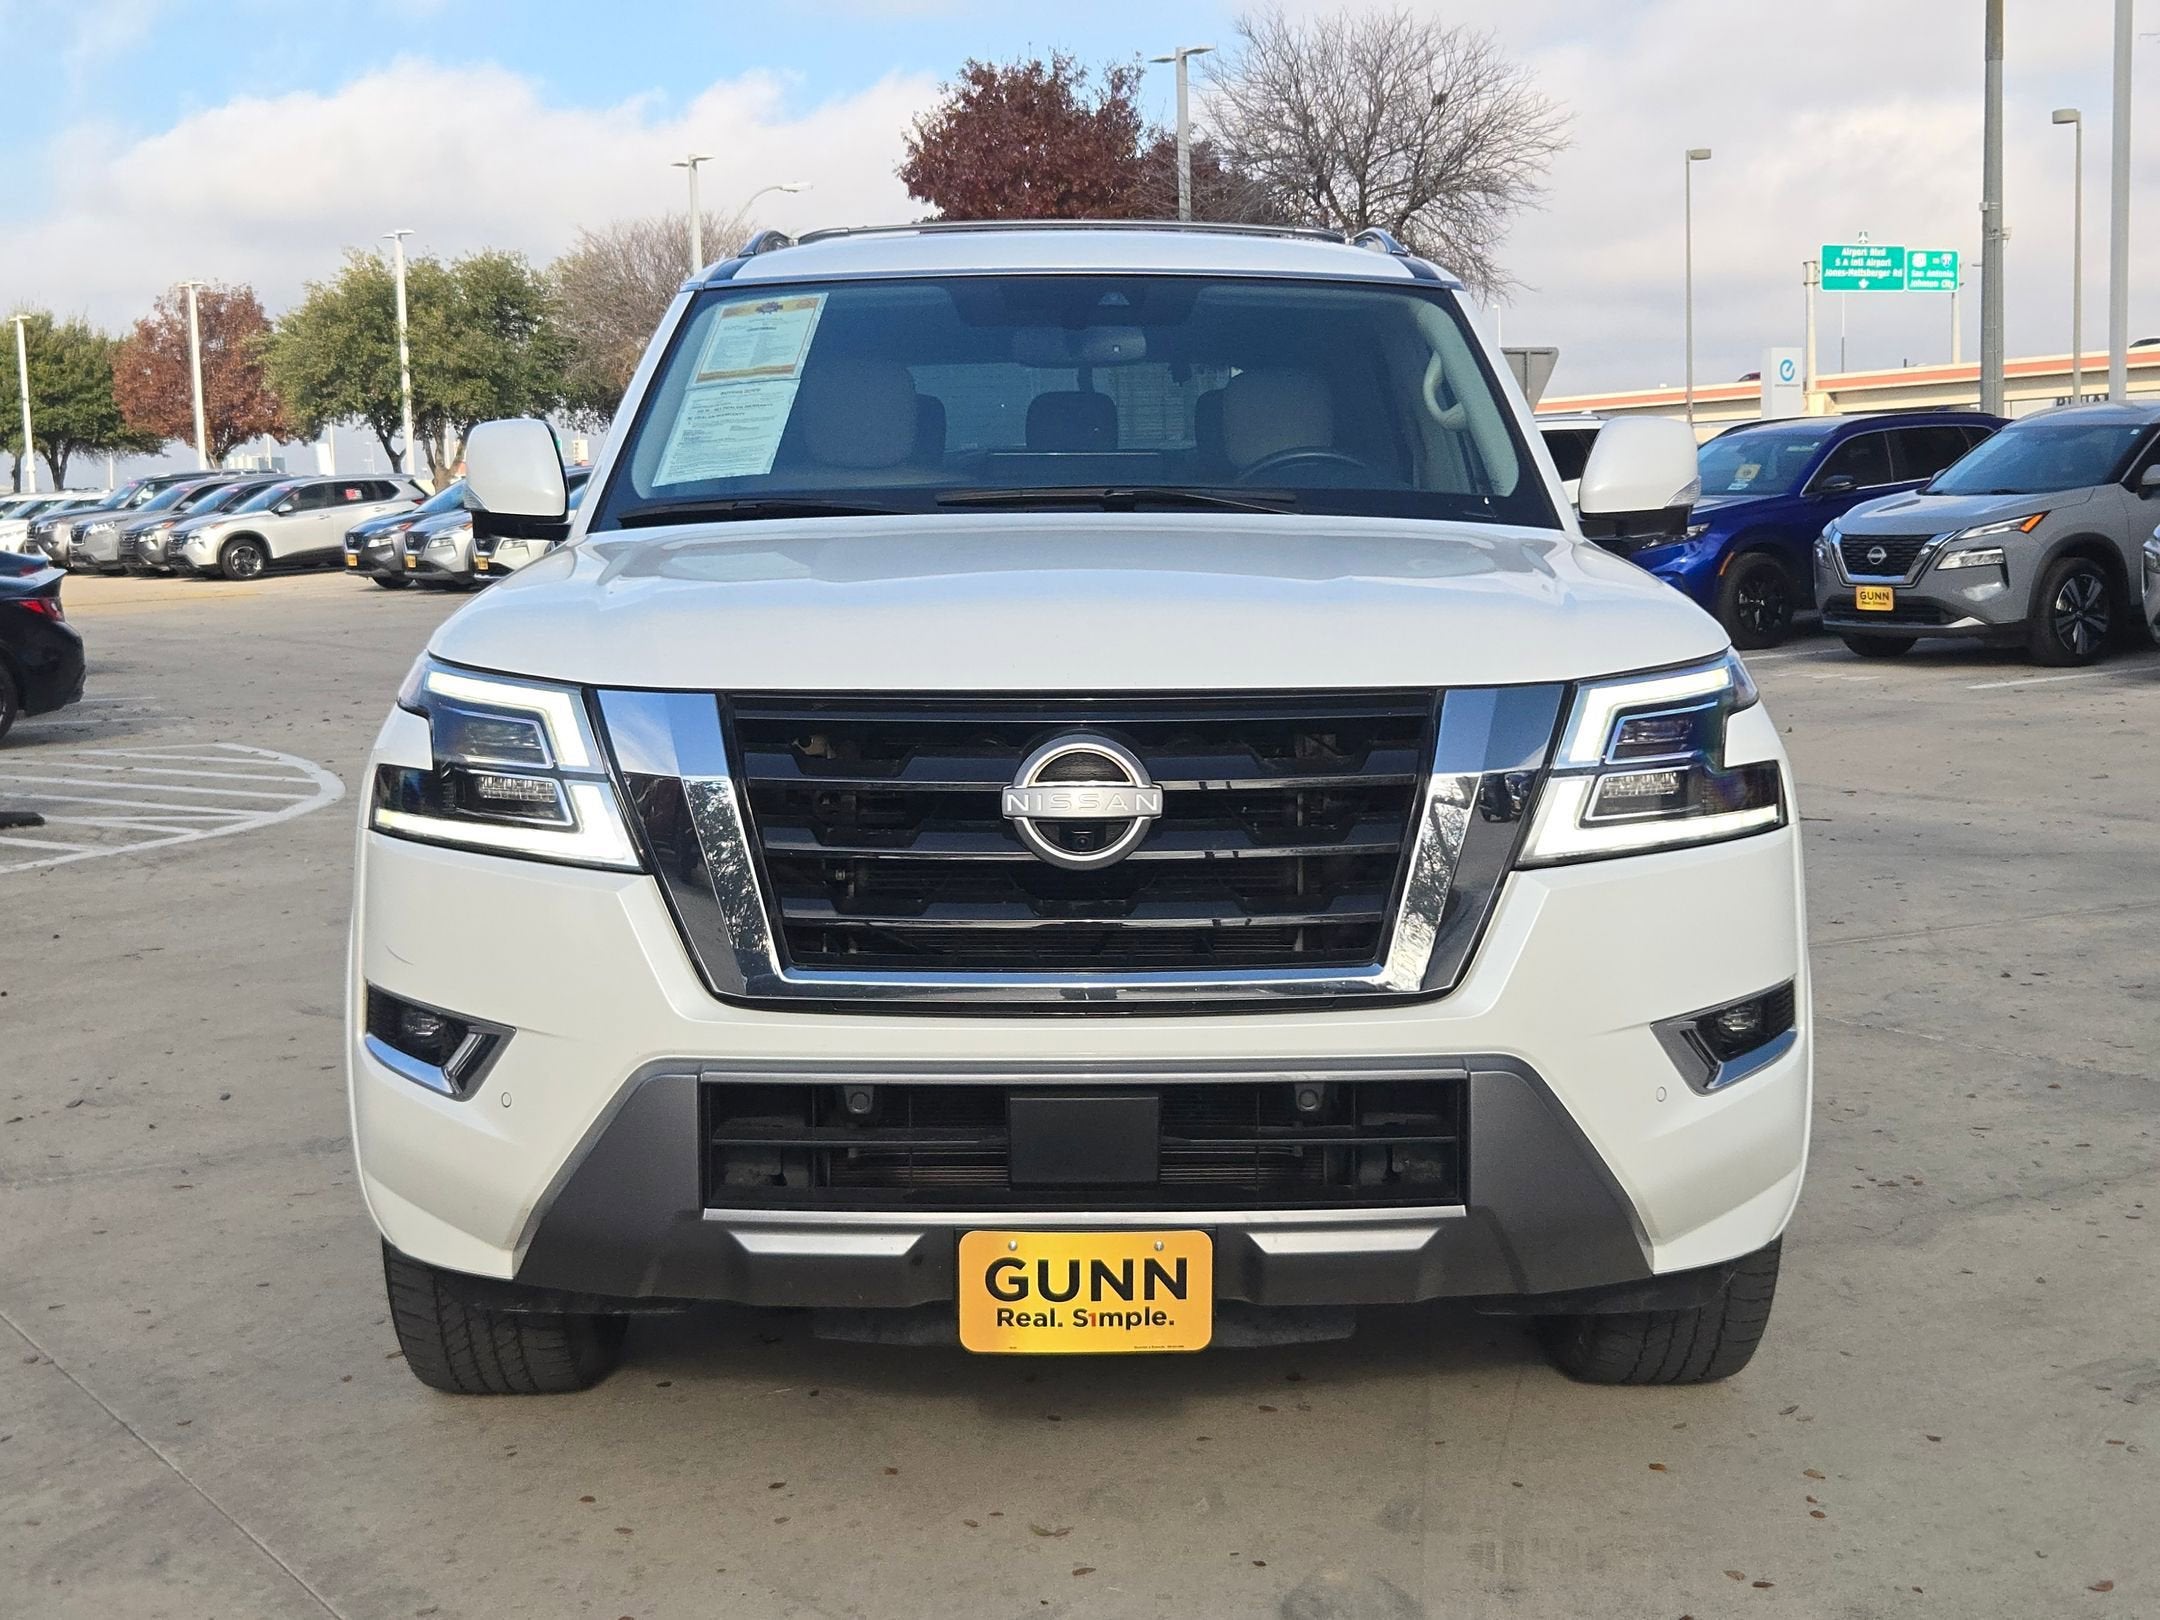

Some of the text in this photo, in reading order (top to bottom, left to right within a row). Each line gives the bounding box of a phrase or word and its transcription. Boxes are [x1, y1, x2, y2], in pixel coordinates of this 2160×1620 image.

[1841, 248, 1867, 258] Airport
[1866, 257, 1892, 268] Airport
[1860, 591, 1890, 601] GUNN
[1007, 793, 1158, 812] NISSAN
[985, 1257, 1188, 1303] GUNN
[997, 1308, 1063, 1328] Real.
